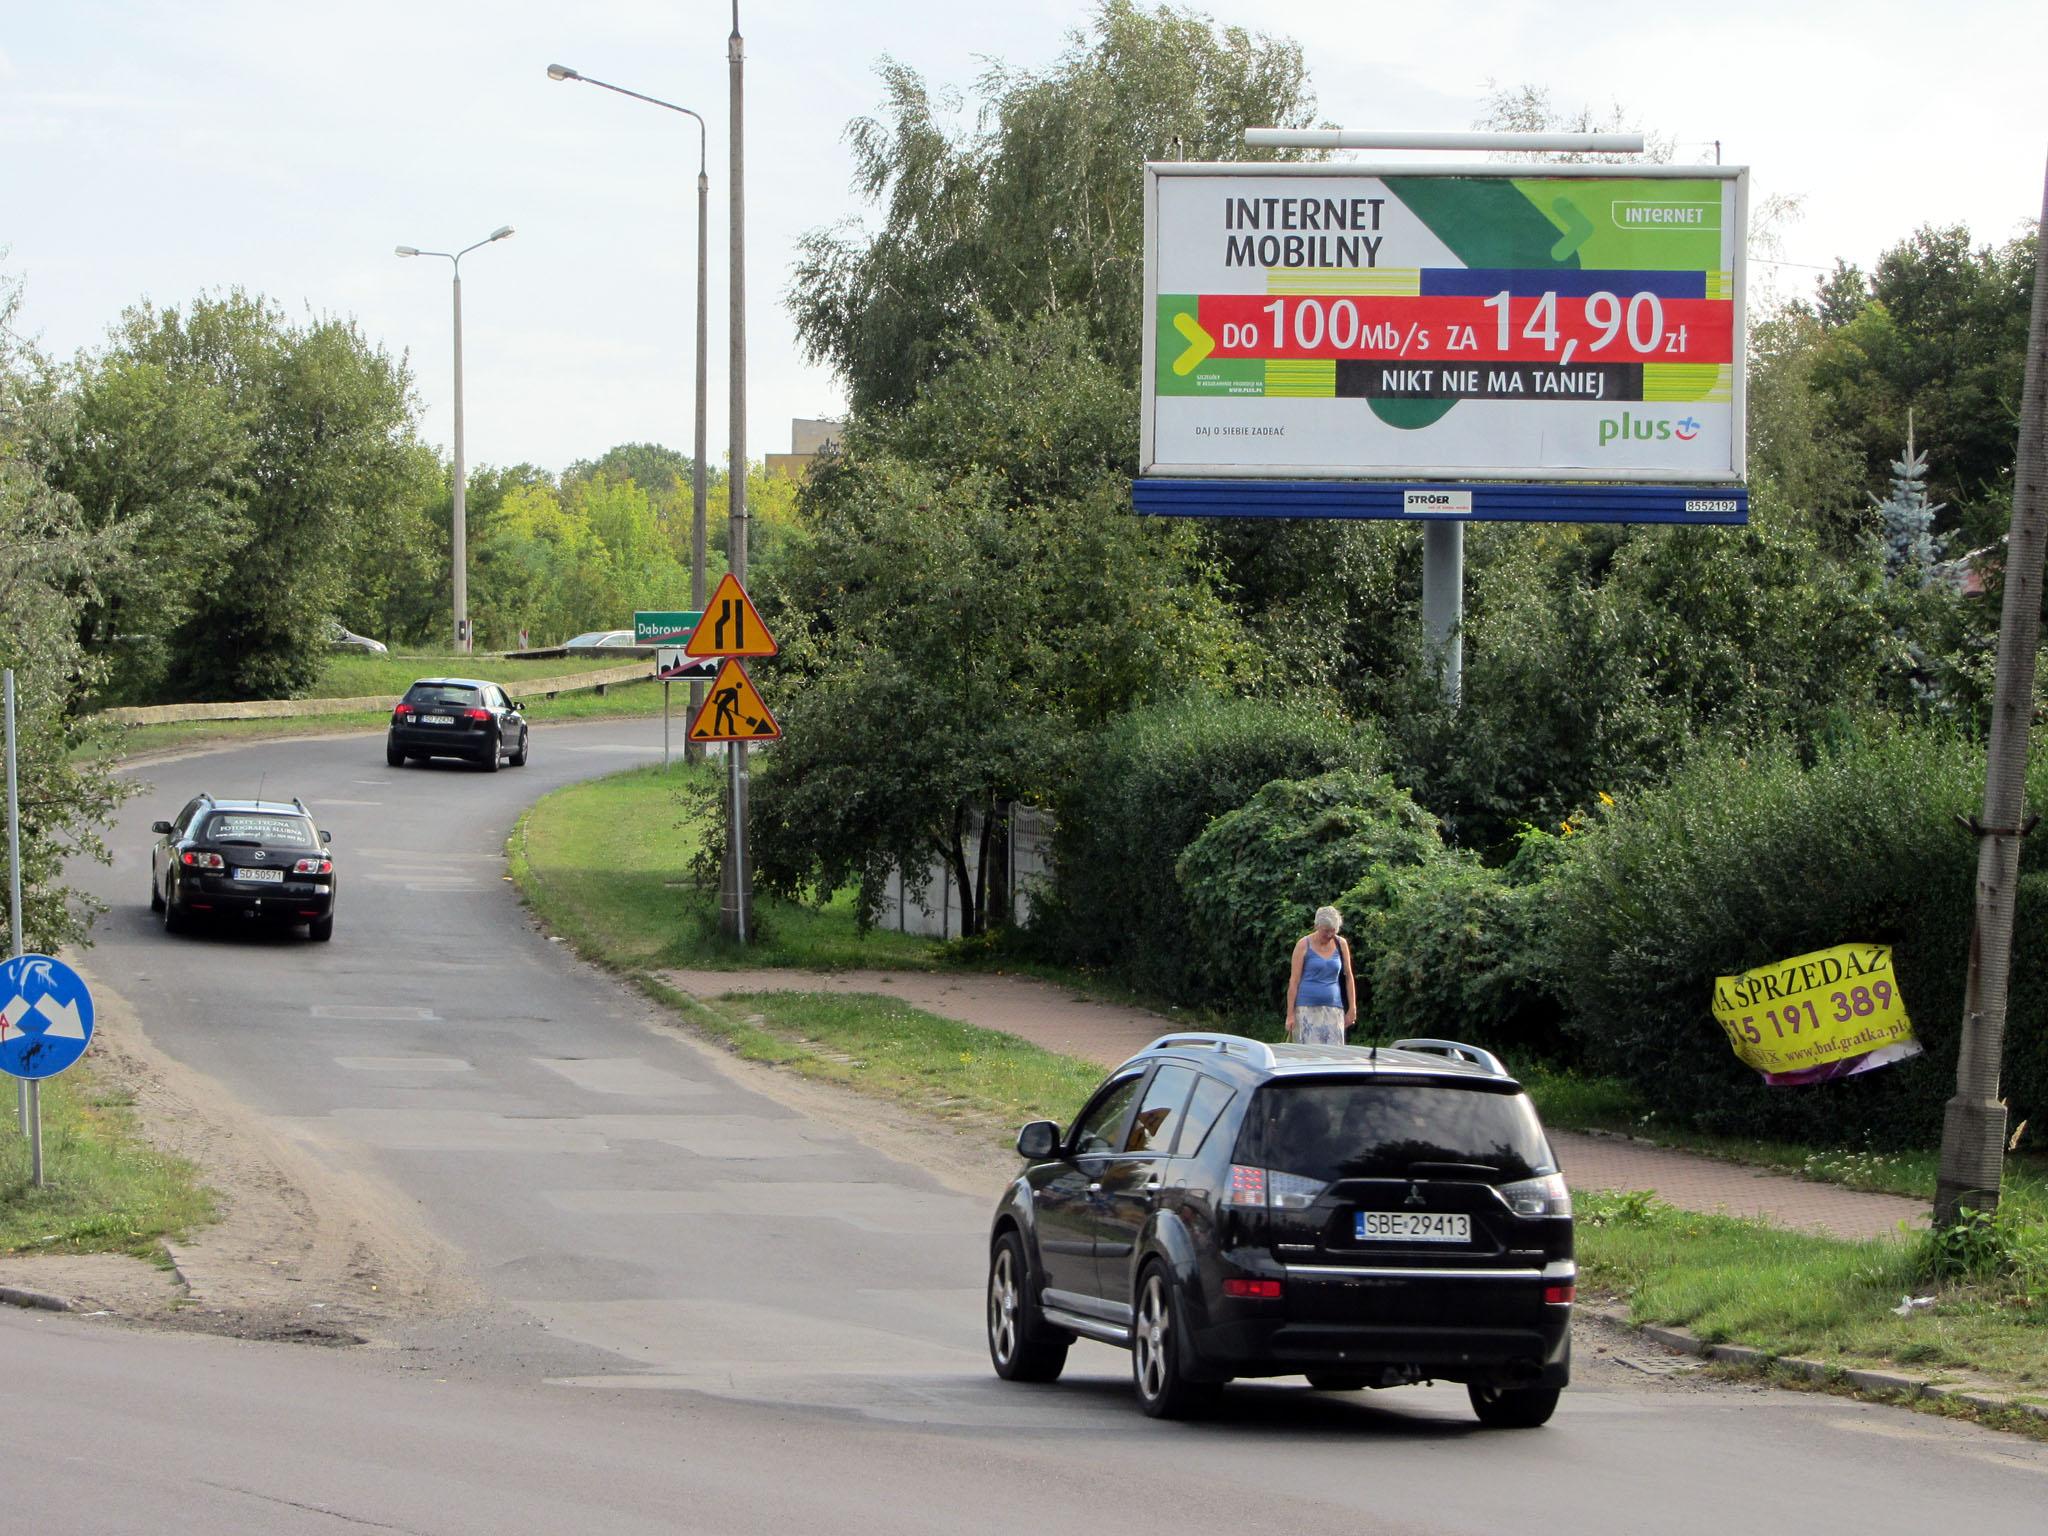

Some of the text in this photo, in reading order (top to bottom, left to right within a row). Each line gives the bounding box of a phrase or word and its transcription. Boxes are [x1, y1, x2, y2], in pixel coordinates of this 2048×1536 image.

[1225, 198, 1385, 231] INTERNET
[1225, 235, 1383, 268] MOBILNY
[1223, 323, 1258, 348] DO
[1446, 325, 1478, 350] ZA
[1382, 370, 1604, 399] NIKT NIE MA TANIEJ
[1195, 426, 1211, 436] DAJ
[1214, 427, 1220, 435] O
[1223, 427, 1249, 436] SIEBIE
[1599, 411, 1671, 447] plus
[1407, 495, 1450, 504] STRÖER
[1687, 501, 1735, 511] 8552192
[240, 869, 282, 880] SD 50571
[1766, 1000, 1820, 1038] 191
[1830, 979, 1893, 1022] 389
[1366, 1214, 1467, 1236] SBE 29413
